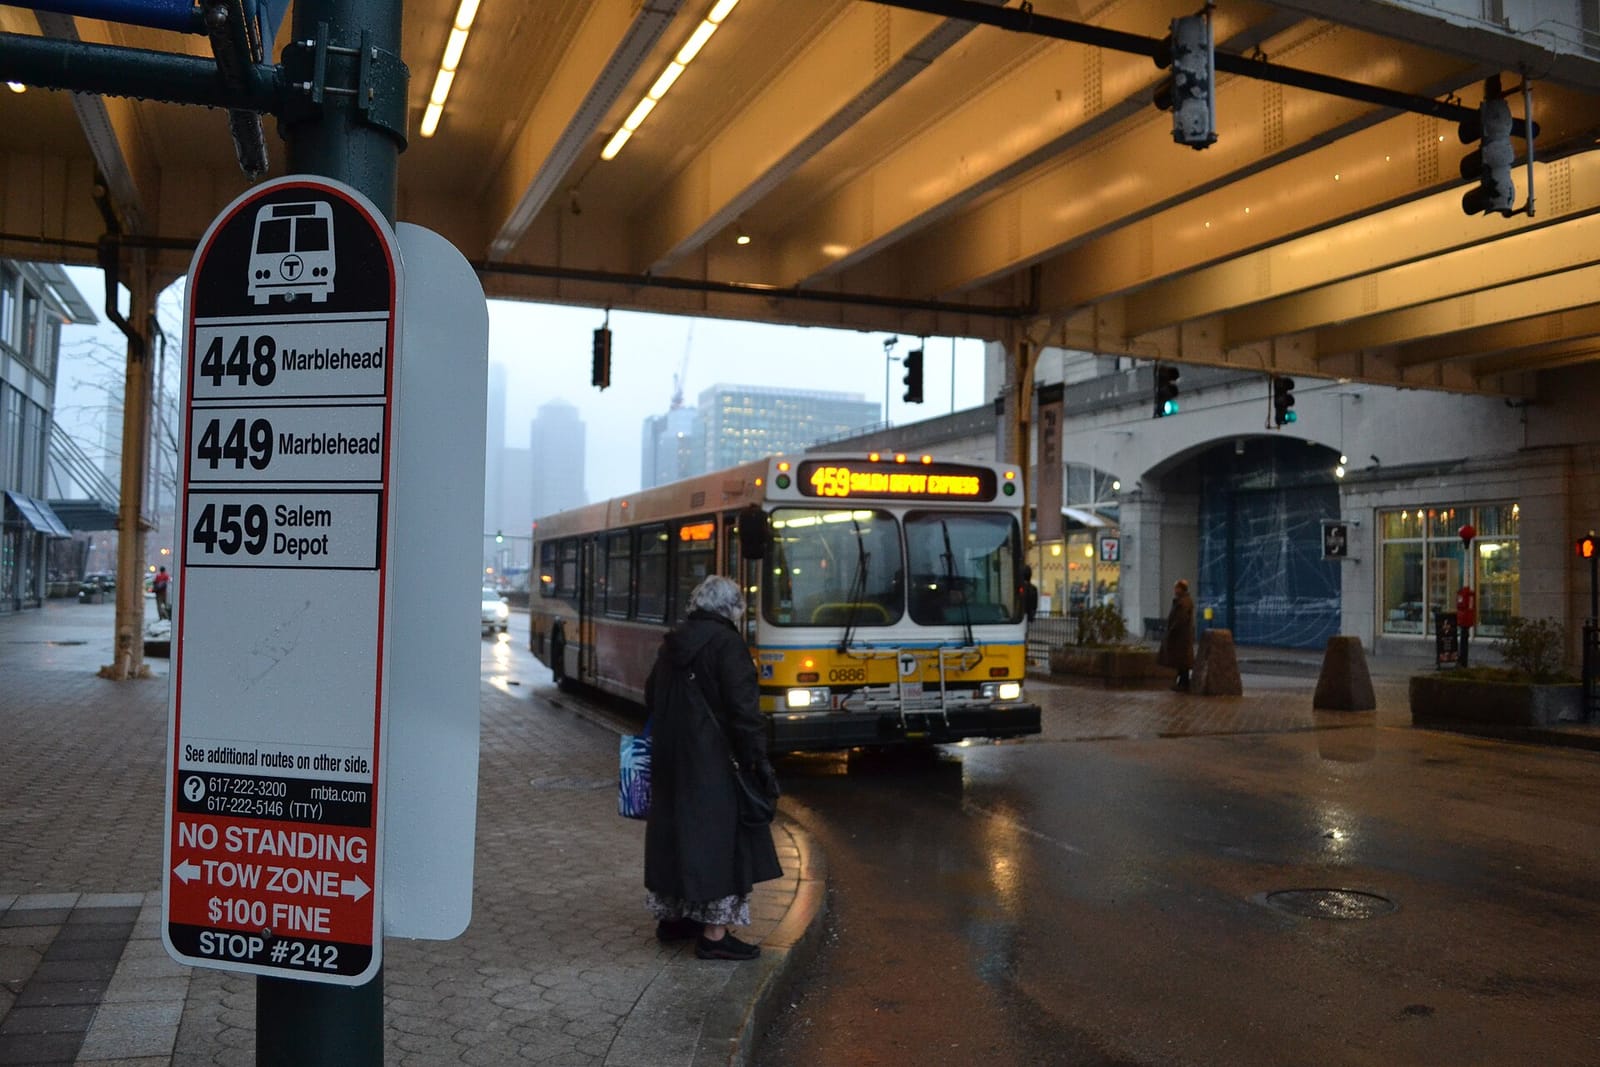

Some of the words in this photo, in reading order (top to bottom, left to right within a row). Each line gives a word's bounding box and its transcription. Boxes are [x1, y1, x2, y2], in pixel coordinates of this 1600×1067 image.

[200, 334, 277, 387] 448
[282, 347, 383, 371] Marblehead
[197, 418, 273, 470] 449
[279, 431, 380, 455] Marblehead
[810, 467, 850, 497] 459
[193, 503, 269, 555] 459
[274, 505, 331, 527] Salem
[273, 533, 329, 559] Depot
[828, 668, 865, 682] 0886
[185, 744, 205, 762] See
[207, 747, 258, 767] additional
[260, 752, 294, 769] routes
[297, 757, 311, 770] on
[313, 754, 342, 771] other
[344, 755, 370, 773] side.
[207, 797, 283, 816] 617-222-5146
[289, 802, 323, 821] (TTY)
[209, 778, 287, 798] 617-222-3200
[311, 785, 367, 803] mbta.com
[178, 823, 218, 850] NO
[225, 826, 368, 864] STANDING
[203, 860, 261, 888] TOW
[266, 866, 339, 898] ZONE
[208, 896, 267, 927] $100
[272, 904, 331, 934] FINE
[199, 931, 264, 960] STOP
[270, 941, 338, 969] #242
